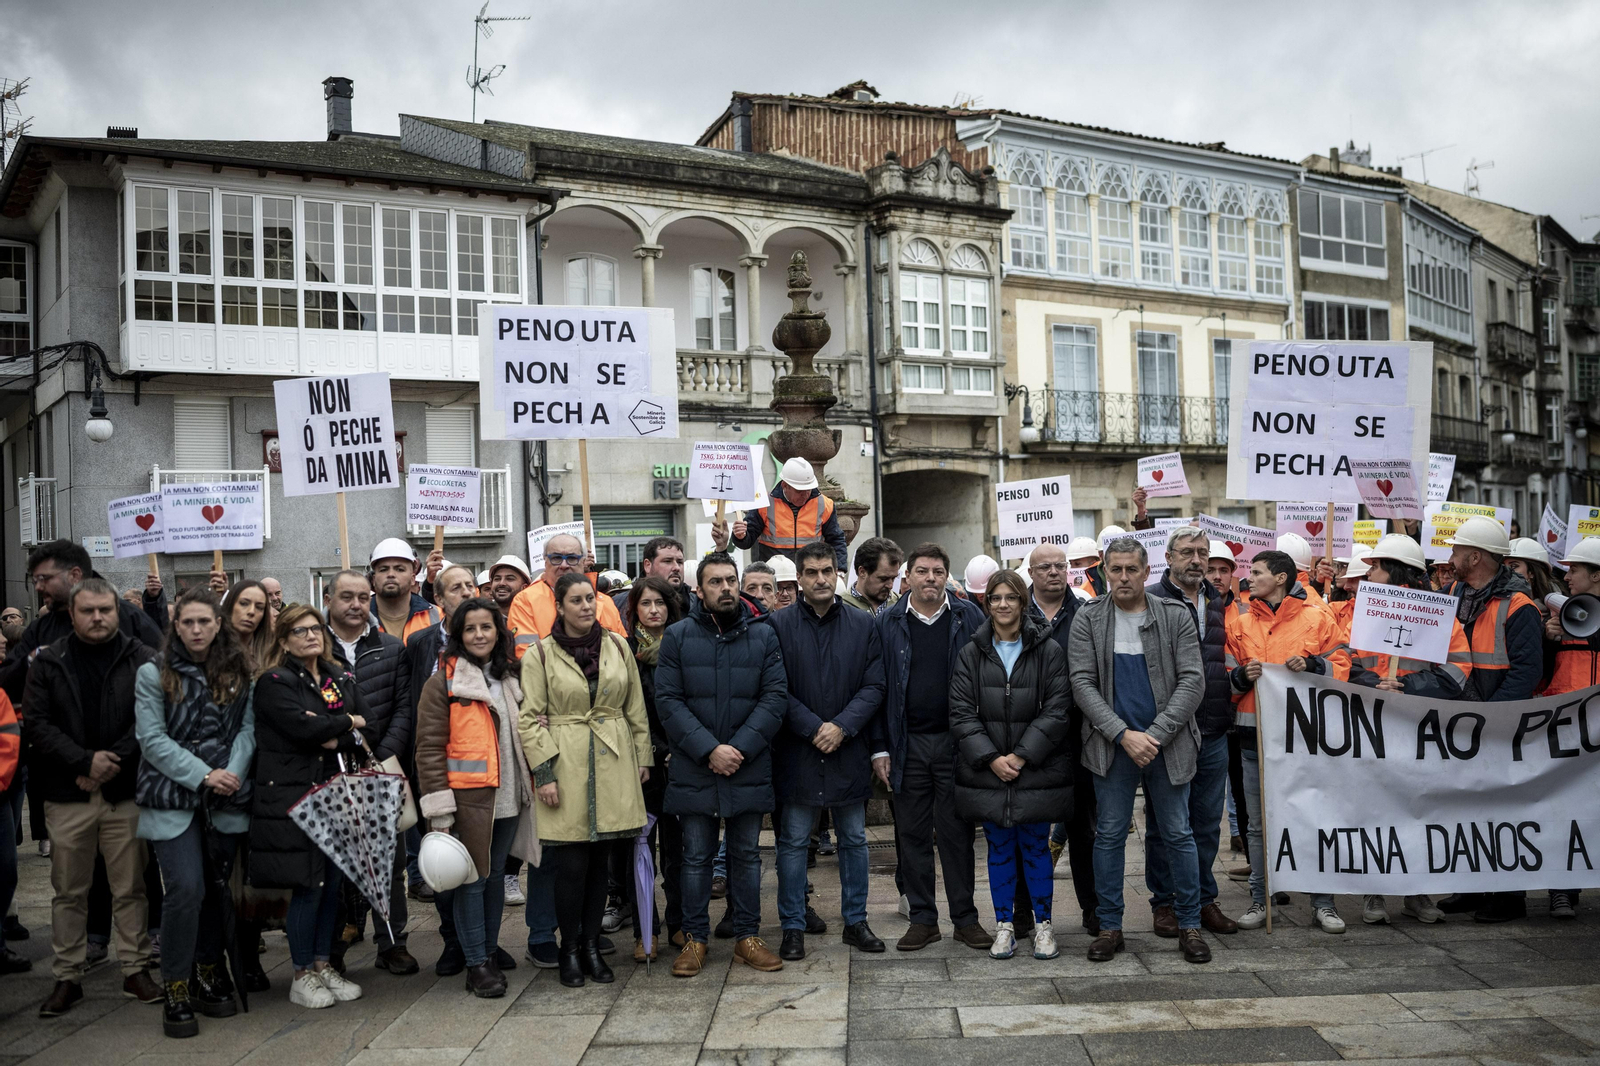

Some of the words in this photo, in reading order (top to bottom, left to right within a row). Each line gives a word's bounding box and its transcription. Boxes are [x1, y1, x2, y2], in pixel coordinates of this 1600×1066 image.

[499, 318, 636, 342] PENOUTA
[506, 362, 568, 384] NON
[597, 363, 626, 385] SE
[1254, 353, 1394, 378] PENOUTA
[308, 378, 351, 415] NON
[513, 401, 610, 425] PECHA
[1252, 411, 1315, 434] NON
[1354, 416, 1386, 438] SE
[304, 418, 314, 452] Ó
[329, 417, 382, 447] PECHE
[306, 456, 328, 484] DA
[336, 450, 391, 488] MINA
[1256, 453, 1352, 477] PECHA
[1390, 470, 1394, 478] É
[184, 497, 221, 506] MINERIA
[224, 495, 228, 504] É
[419, 490, 465, 498] MENTIROSOS
[997, 488, 1030, 501] PENSO
[1042, 482, 1060, 496] NO
[121, 507, 151, 517] MINERIA
[1016, 510, 1053, 523] FUTURO
[1432, 515, 1452, 524] STOP
[1451, 507, 1495, 516] ECOLOXETAS
[1135, 529, 1168, 539] CONTAMINA!
[1206, 519, 1219, 527] MINA
[1235, 526, 1274, 538] CONTAMINA!
[1001, 536, 1036, 547] URBANITA
[1041, 534, 1069, 545] PURO
[1213, 530, 1241, 542] MINERIA
[1249, 539, 1270, 547] VIDA!
[1367, 597, 1389, 607] TSXG,
[1408, 604, 1444, 616] FAMILIAS
[1406, 592, 1455, 605] CONTAMINA!
[1366, 609, 1402, 621] ESPERAN
[1403, 615, 1438, 627] XUSTICIA
[1285, 687, 1386, 759] NON
[1416, 708, 1486, 760] AO
[1275, 828, 1297, 872] A
[1318, 826, 1408, 874] MINA
[1426, 821, 1543, 874] DANOS
[1567, 820, 1593, 871] A
